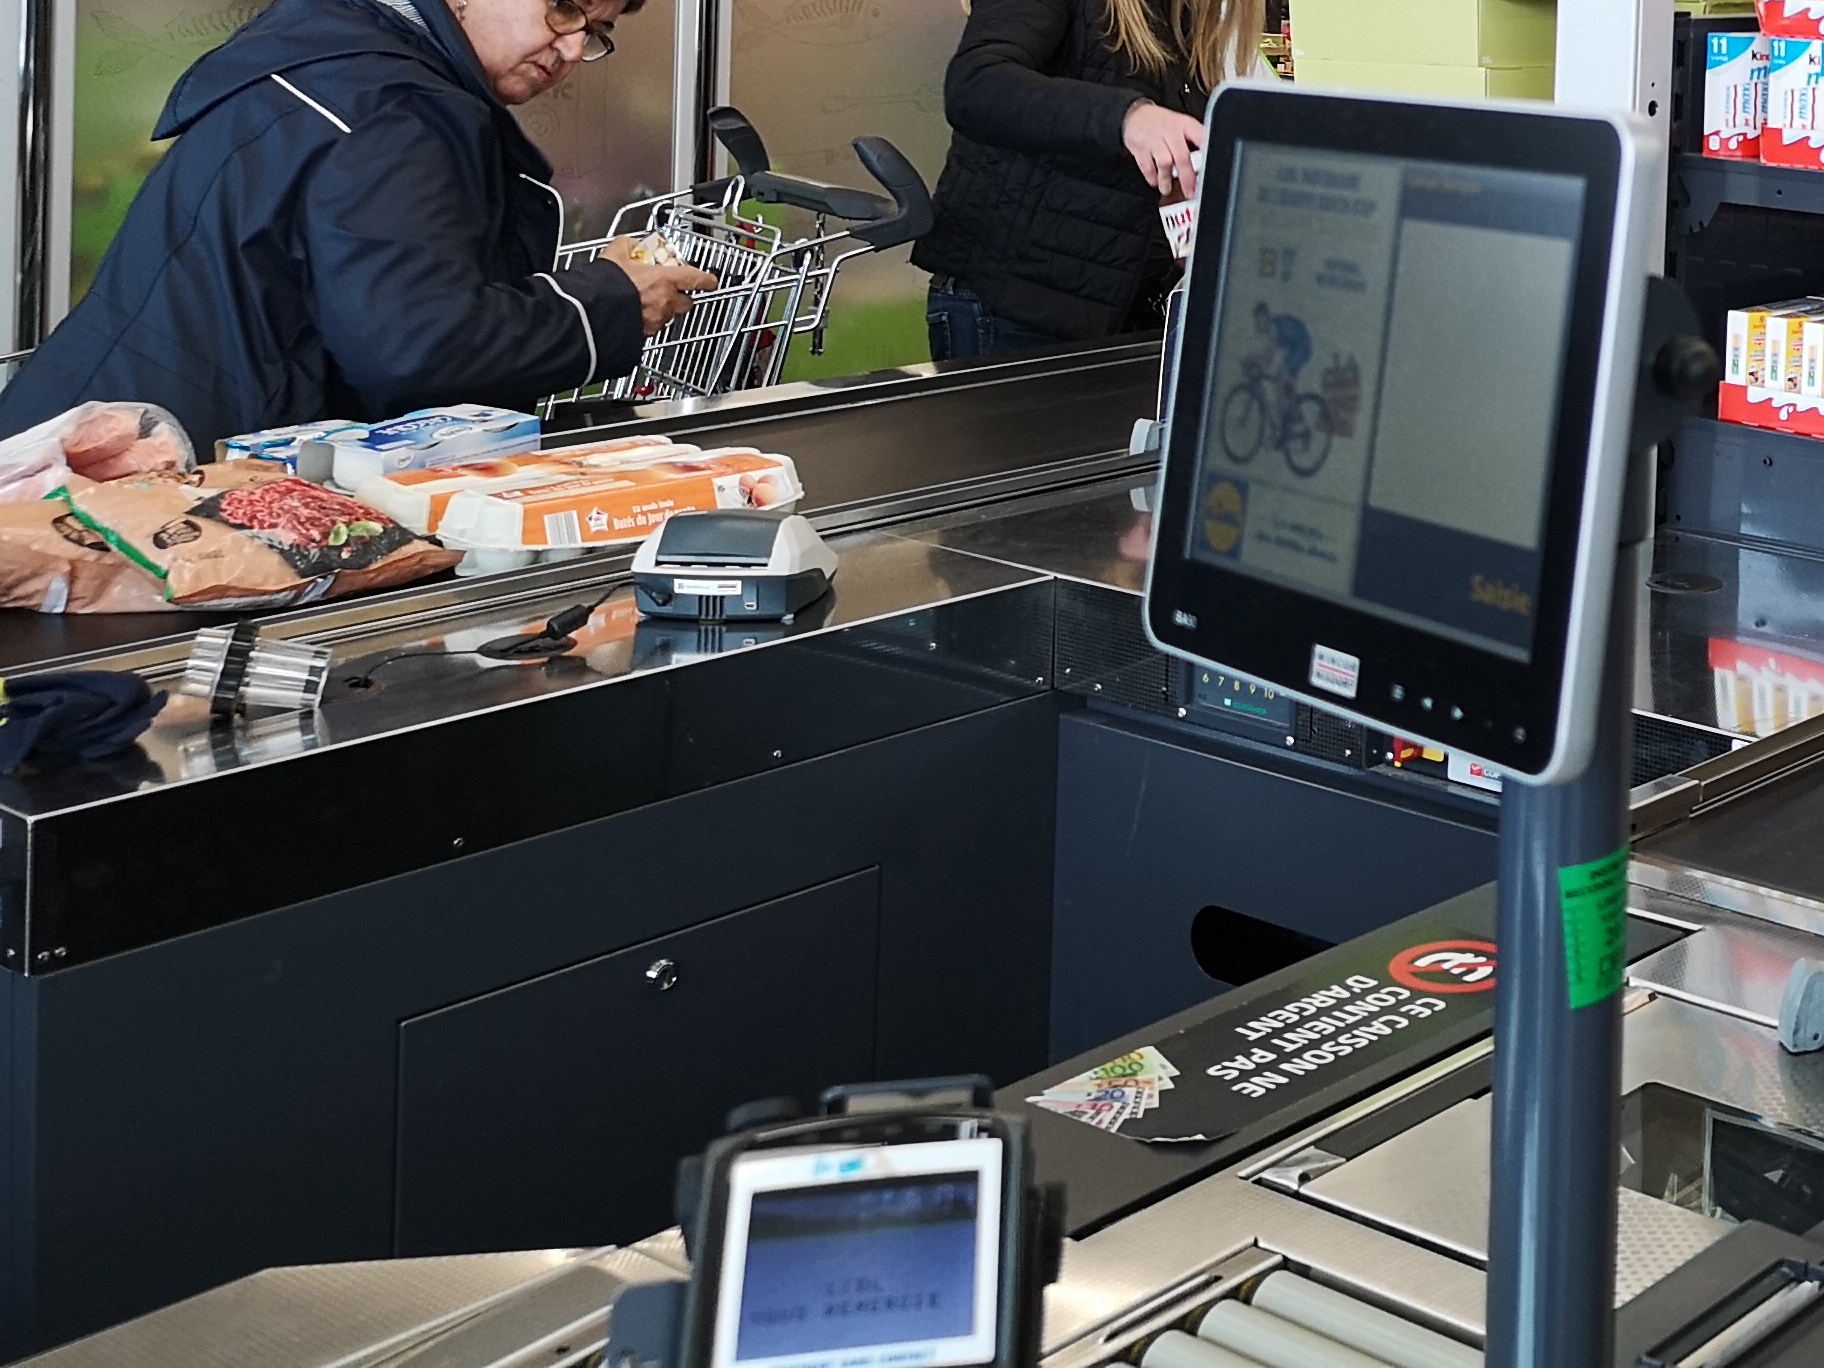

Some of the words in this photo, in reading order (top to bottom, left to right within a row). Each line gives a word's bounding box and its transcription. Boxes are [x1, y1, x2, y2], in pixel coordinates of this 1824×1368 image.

[1711, 37, 1727, 54] 11
[1773, 40, 1786, 57] 11
[1202, 673, 1209, 683] 6
[1218, 676, 1225, 687] 7
[1233, 680, 1240, 691] 8
[1249, 683, 1256, 695] 9
[1263, 688, 1275, 700] 10
[1234, 974, 1379, 1041] D'ARGENT
[1399, 997, 1447, 1019] CE
[1270, 986, 1411, 1053] CONTIENT
[1278, 1014, 1410, 1076] CAISSON
[1206, 1047, 1278, 1081] PAS
[1231, 1071, 1290, 1098] NE
